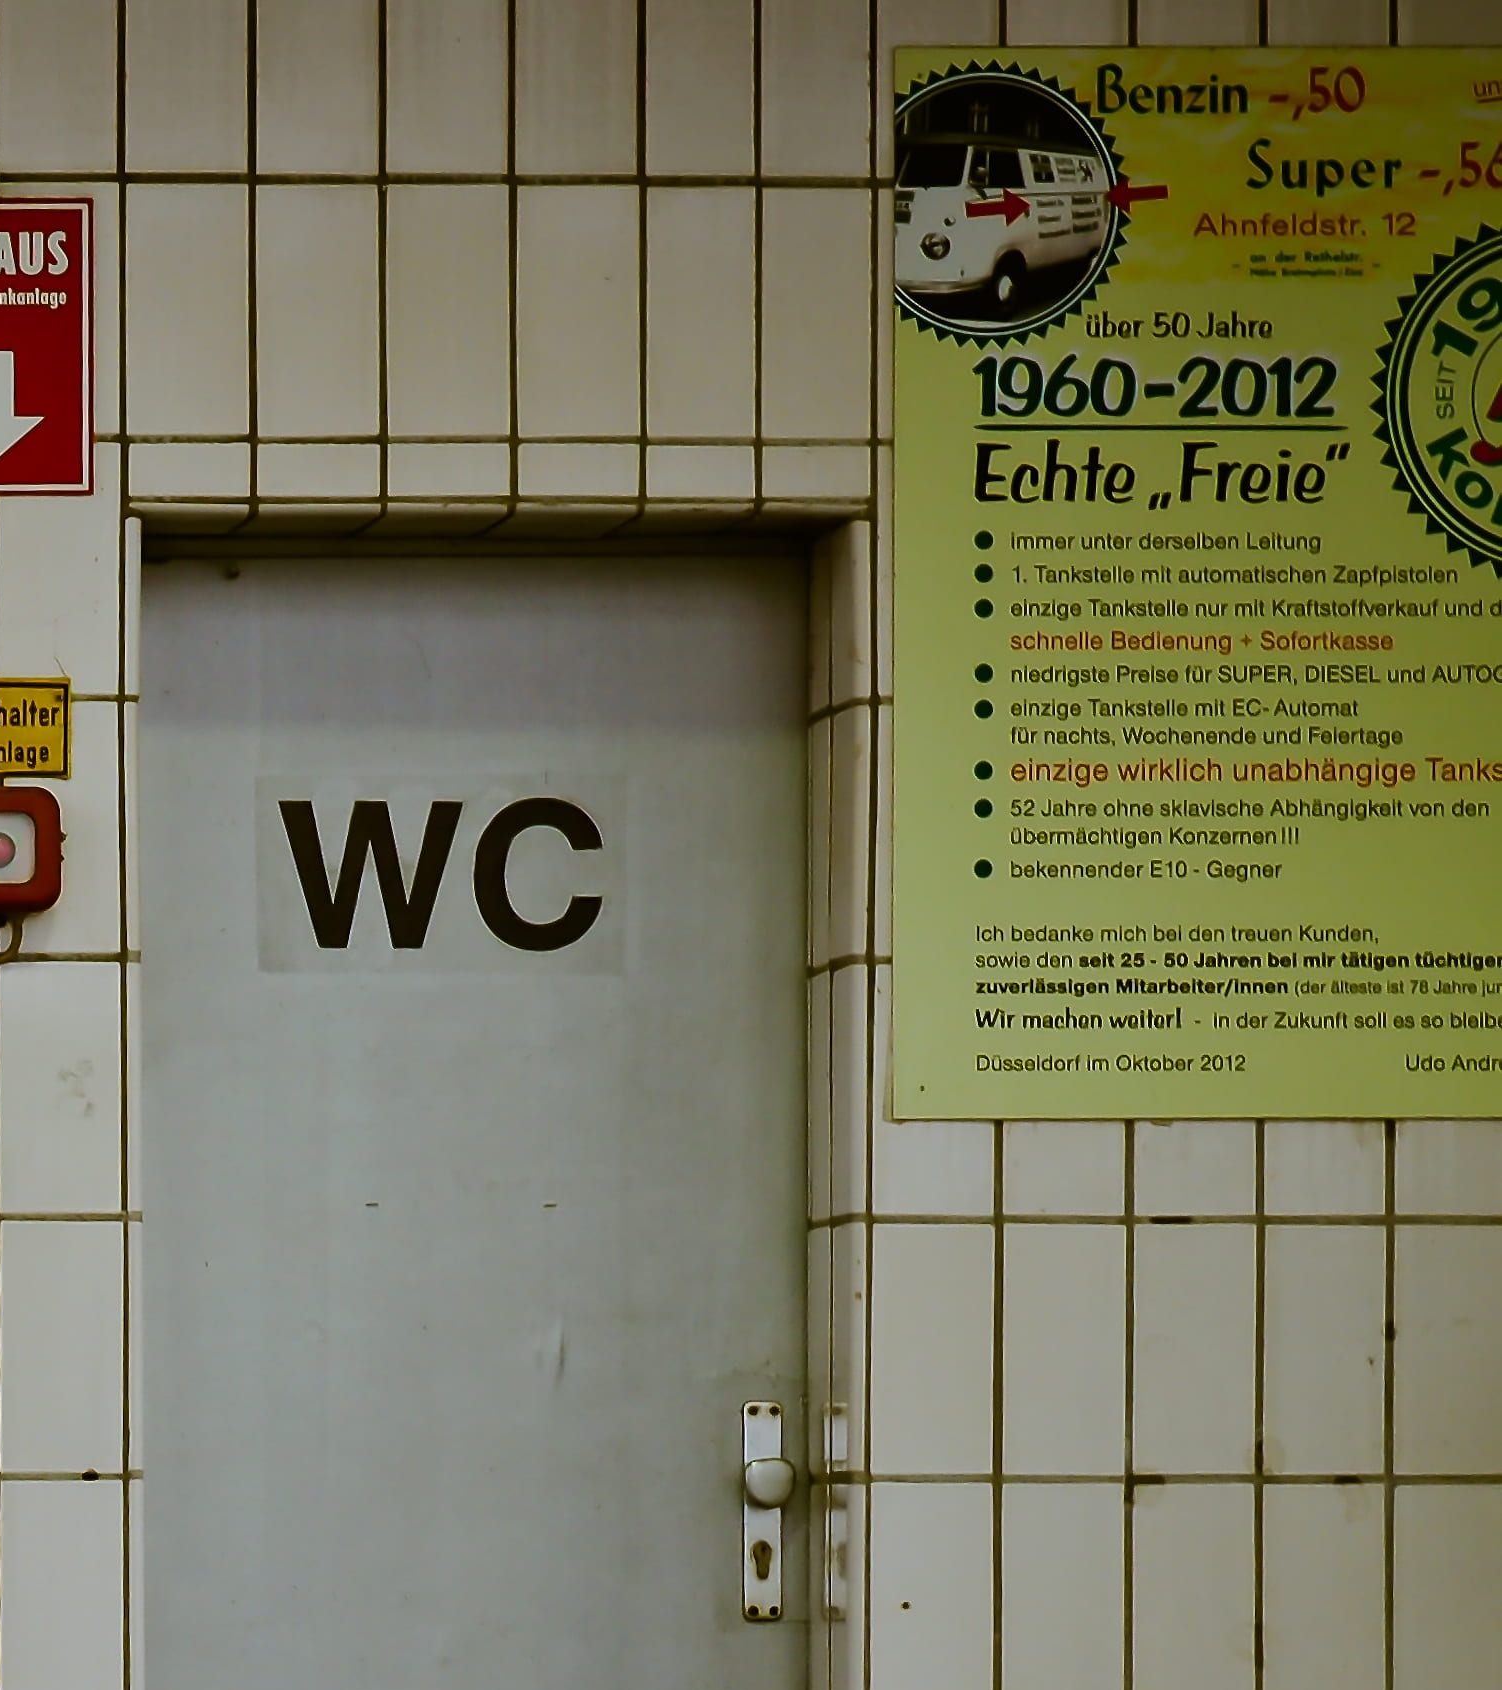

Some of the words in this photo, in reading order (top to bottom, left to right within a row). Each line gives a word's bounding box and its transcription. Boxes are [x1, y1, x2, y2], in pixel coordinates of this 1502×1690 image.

[1095, 65, 1249, 114] Benzin
[1248, 139, 1403, 198] Super
[1194, 212, 1367, 238] Ahnfeldstr.
[1382, 212, 1417, 238] 12
[1084, 311, 1146, 340] über
[1153, 312, 1193, 339] 50
[1196, 311, 1274, 340] Jahre
[973, 355, 1336, 419] 1960-2012
[1436, 361, 1457, 420] SEIT
[974, 439, 1137, 505] Echte
[1010, 532, 1077, 552] immer
[1080, 533, 1134, 552] unter
[1137, 532, 1240, 552] derselben
[1247, 532, 1322, 556] Leitung
[1011, 566, 1028, 585] 1.
[1034, 563, 1136, 586] Tankstelle
[1141, 566, 1173, 585] mit
[1179, 565, 1328, 585] automatischen
[1333, 565, 1459, 589] Zapfpistolen
[1009, 631, 1104, 653] schnelle
[1110, 631, 1234, 657] Bedienung
[1241, 635, 1254, 648] +
[1261, 631, 1395, 652] Sofortkasse
[1010, 758, 1110, 789] einzige
[1116, 758, 1223, 784] wirklich
[1234, 758, 1417, 789] unabhängige
[278, 799, 604, 952] WC
[975, 1008, 1017, 1030] Wir
[1022, 1007, 1105, 1031] machen
[975, 1055, 1082, 1074] Düsseldorf
[1086, 1055, 1112, 1073] im
[1115, 1055, 1196, 1074] Oktober
[1201, 1055, 1247, 1073] 2012
